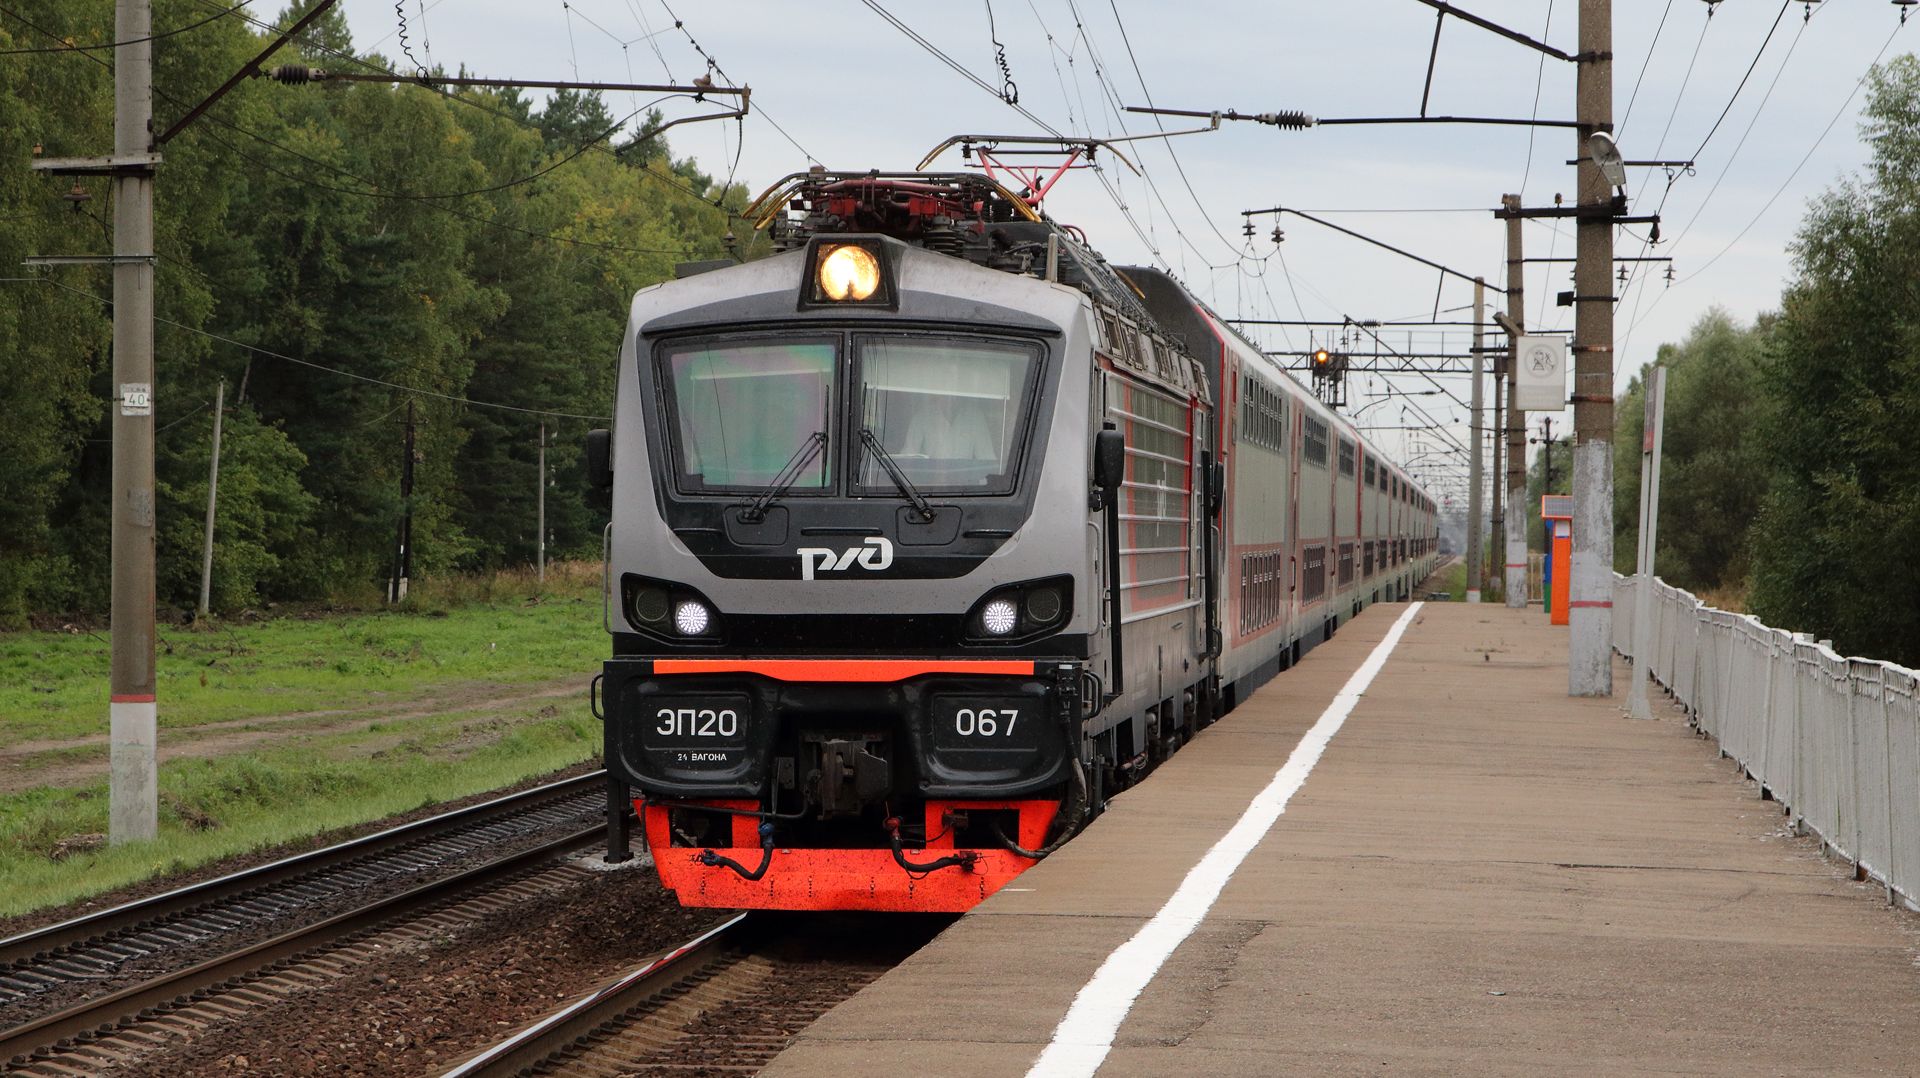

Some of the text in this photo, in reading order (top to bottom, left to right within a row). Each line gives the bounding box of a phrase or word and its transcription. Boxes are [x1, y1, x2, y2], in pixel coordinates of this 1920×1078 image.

[129, 393, 145, 405] 40
[656, 708, 737, 737] ЭП20
[955, 708, 1019, 737] 067
[691, 753, 728, 761] ВАГОНА
